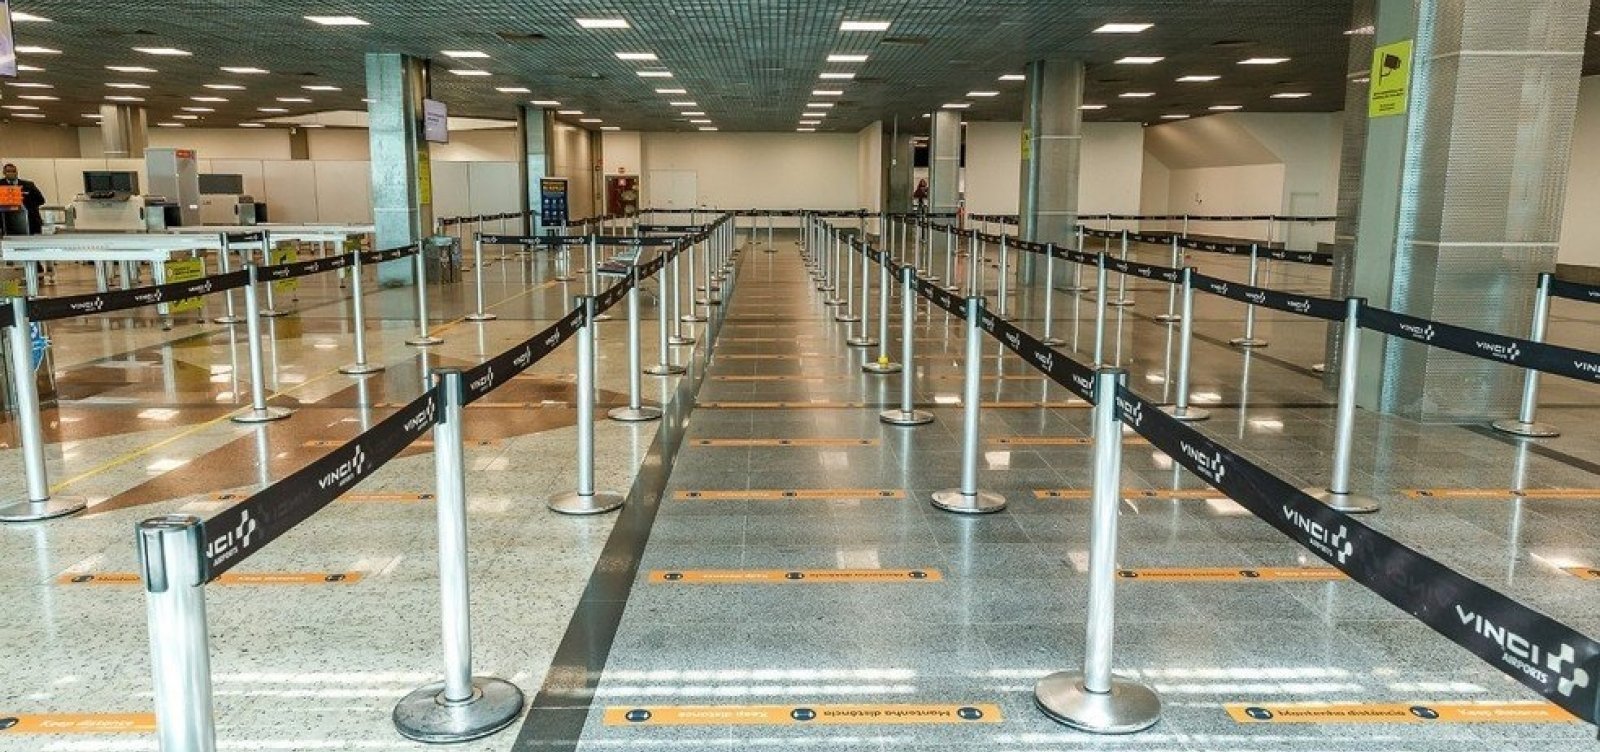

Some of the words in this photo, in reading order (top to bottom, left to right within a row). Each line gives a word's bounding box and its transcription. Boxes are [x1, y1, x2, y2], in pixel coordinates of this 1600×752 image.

[1400, 323, 1424, 335] VINCI
[1476, 341, 1506, 354] VINCI
[1180, 441, 1211, 466] VINCI
[318, 461, 352, 489] VINCI
[1283, 505, 1328, 542] VINCI
[1455, 604, 1540, 666] VINCI
[1501, 651, 1549, 685] AIRPORTS
[884, 710, 951, 718] Mantenha
